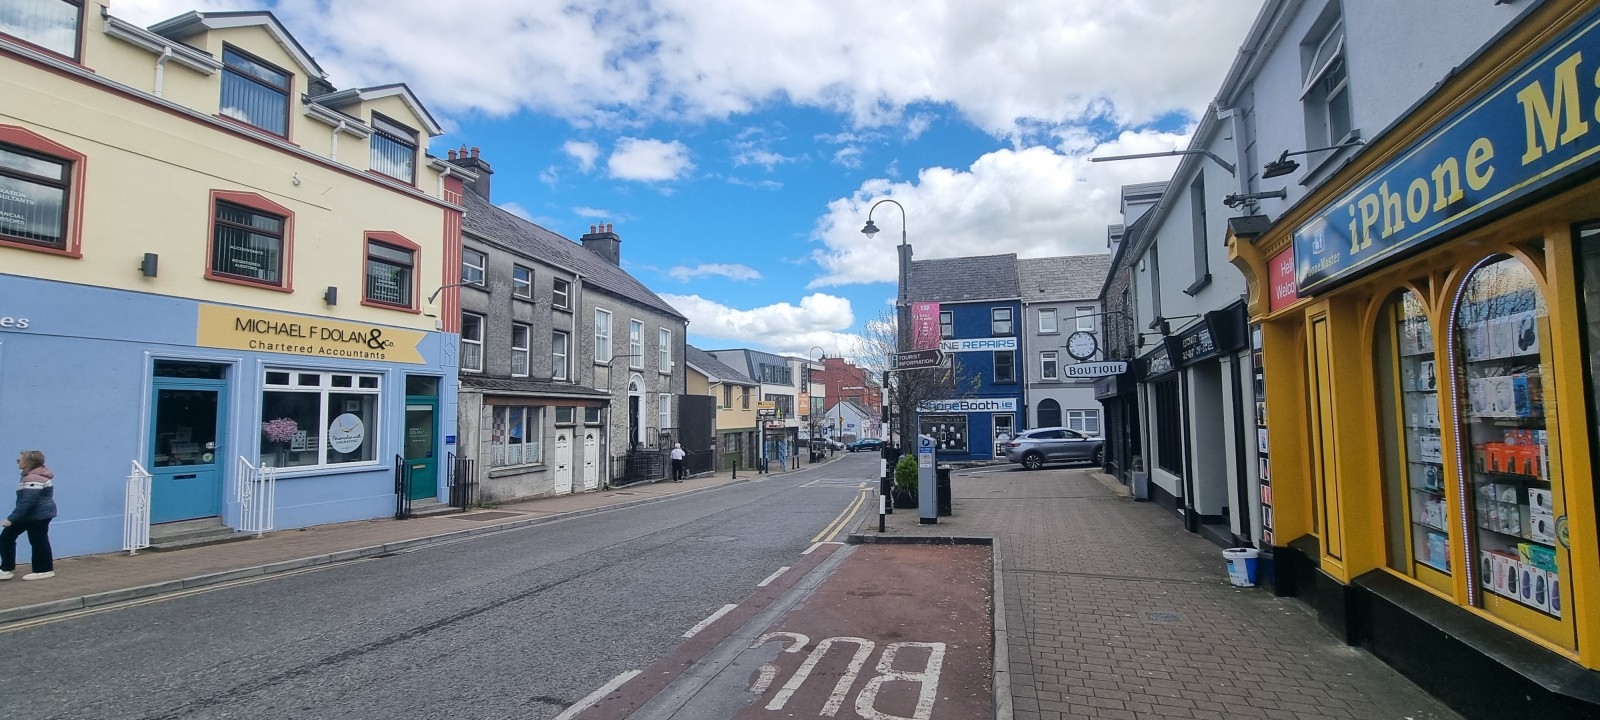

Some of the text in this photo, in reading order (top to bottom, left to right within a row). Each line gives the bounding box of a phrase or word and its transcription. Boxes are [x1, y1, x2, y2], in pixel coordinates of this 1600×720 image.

[1349, 51, 1600, 256] iPhone M
[1276, 280, 1297, 299] Welco
[235, 317, 306, 338] MICHAEL
[310, 326, 318, 338] F
[249, 339, 386, 360] Chartered Accountants
[962, 339, 1015, 349] REPAIRS
[899, 353, 920, 361] TOURIST
[899, 359, 934, 367] INFORMATION
[1070, 364, 1124, 375] BOUTIQUE
